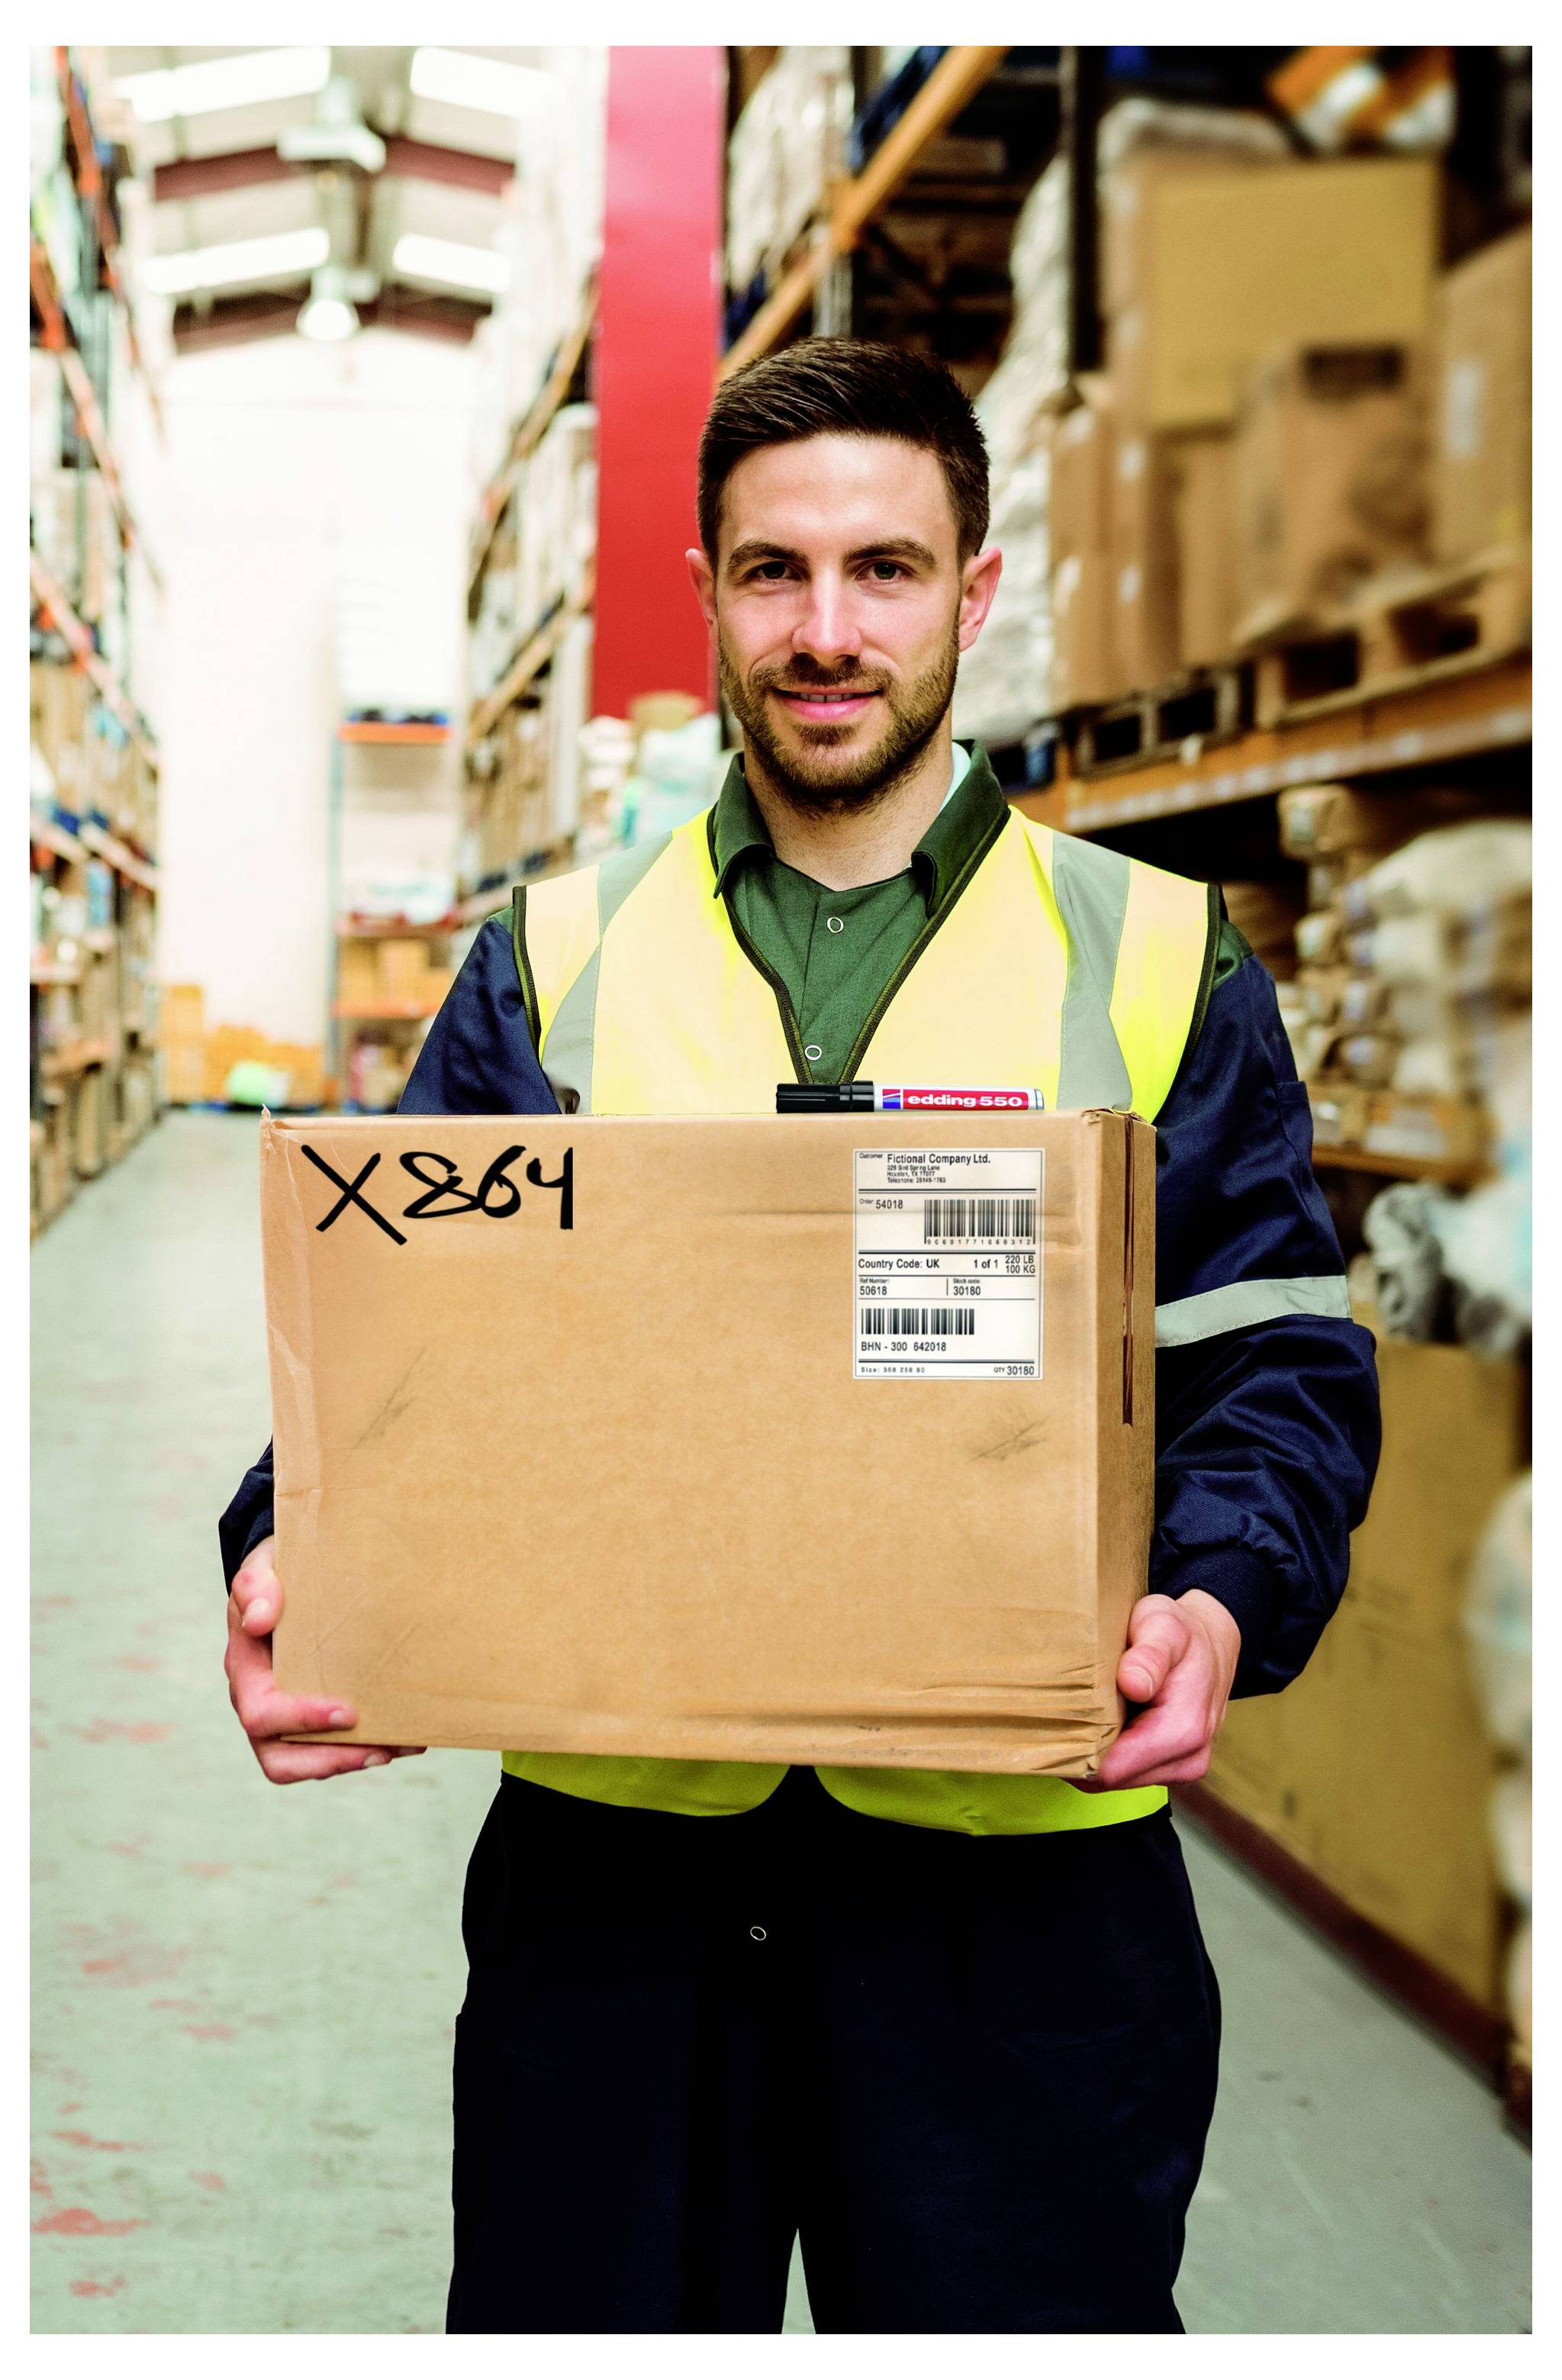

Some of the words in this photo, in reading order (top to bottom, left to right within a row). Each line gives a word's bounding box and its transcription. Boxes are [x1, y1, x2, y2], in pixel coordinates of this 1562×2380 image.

[907, 1094, 977, 1107] edding
[978, 1096, 1023, 1107] 550
[887, 1154, 926, 1163] Fictional
[929, 1154, 971, 1165] Company
[974, 1154, 990, 1163] Ltd.
[875, 1200, 903, 1209] 54018
[974, 1260, 977, 1268] 1
[982, 1260, 991, 1268] of
[994, 1260, 998, 1268] 1
[1005, 1255, 1019, 1264] 220
[1023, 1255, 1034, 1264] LB
[858, 1259, 894, 1271] Country
[897, 1260, 923, 1268] Code:
[926, 1260, 939, 1268] UK
[1006, 1265, 1019, 1274] 100
[1023, 1265, 1035, 1274] KG
[860, 1287, 887, 1296] 50618
[953, 1287, 981, 1296] 30180
[861, 1342, 881, 1351] BHN
[891, 1342, 907, 1351] 300
[913, 1342, 946, 1351] 642018
[1006, 1366, 1034, 1375] 30180
